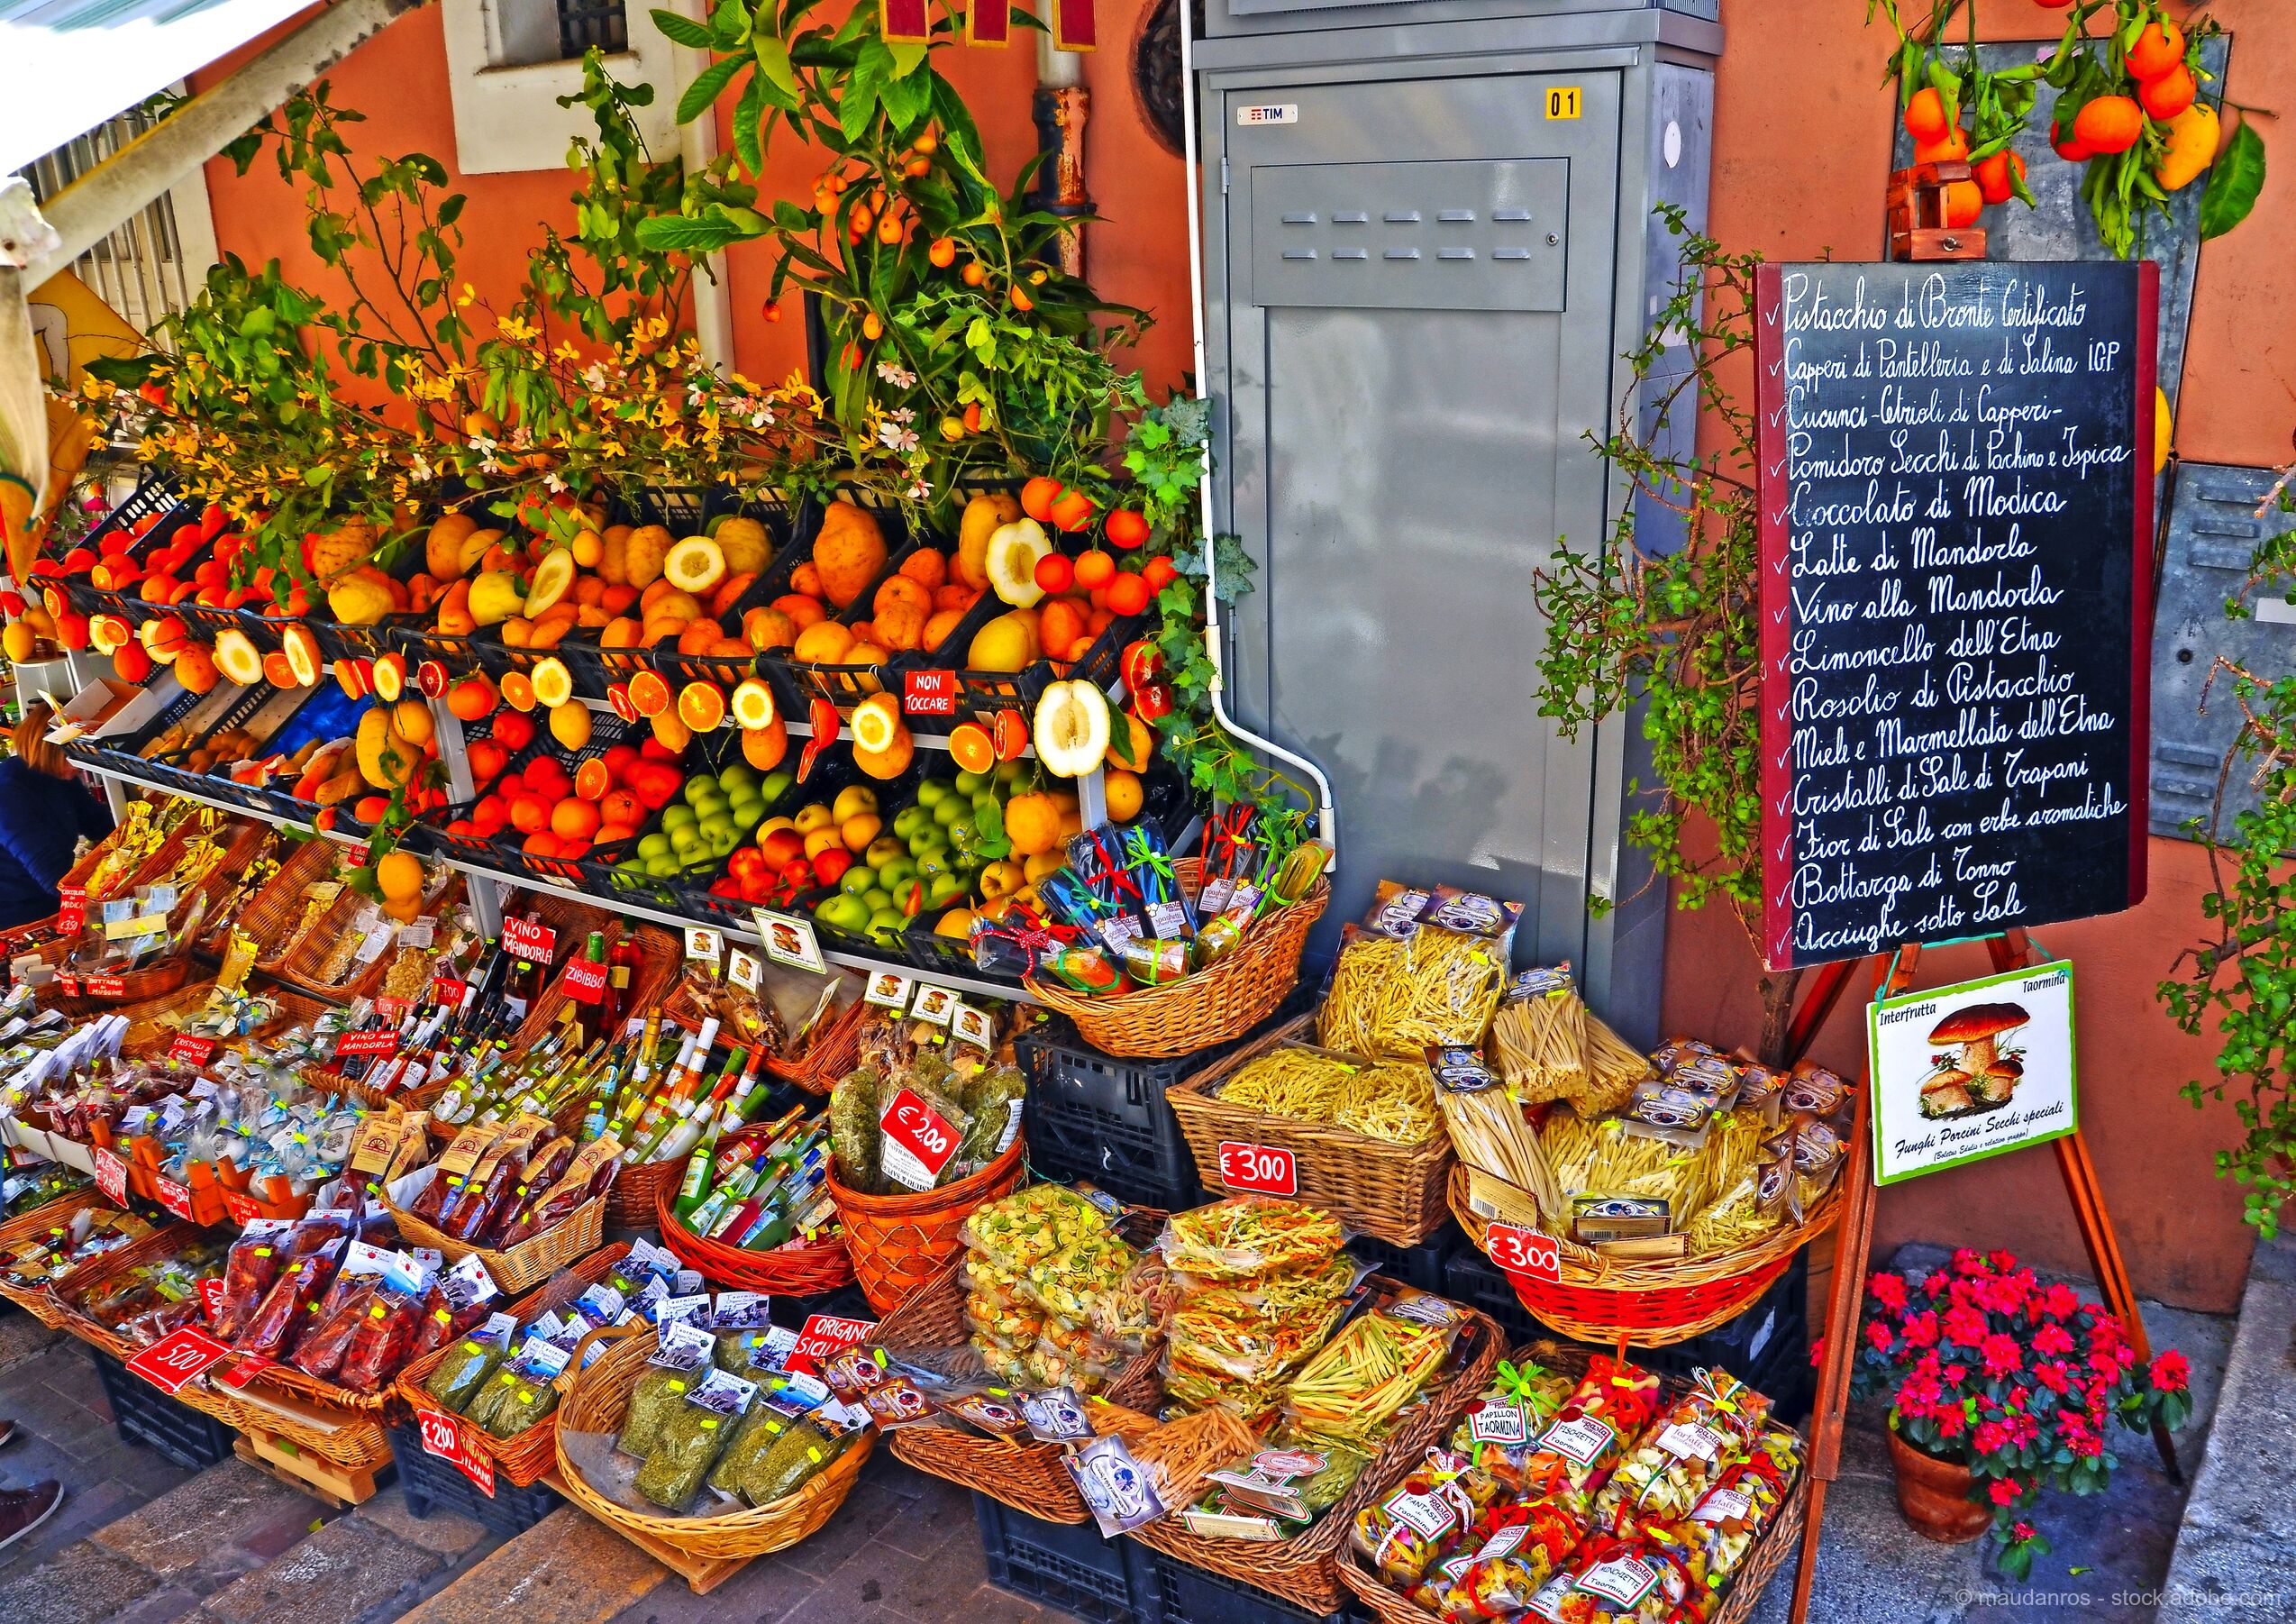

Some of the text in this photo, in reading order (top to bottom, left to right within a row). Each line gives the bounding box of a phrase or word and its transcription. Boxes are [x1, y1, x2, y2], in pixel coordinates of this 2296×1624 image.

[1263, 108, 1282, 119] TIM
[1783, 273, 2087, 338] Pistacchio di Bronte Certificato
[1785, 337, 1847, 388] Capperi
[1853, 341, 1872, 379] di
[1876, 337, 1973, 379] Pantelleria
[1980, 359, 1991, 377] e
[1996, 336, 2015, 375] di
[2019, 332, 2079, 375] Salina
[1786, 384, 1868, 431] Cucunci
[1947, 395, 1970, 423] di
[1786, 424, 2132, 481] Pomidoro Secchi di Pachino e Ispica
[1787, 476, 2068, 528] Cioccolato di Modica
[1790, 523, 2037, 579] Latte di Mandorla
[1790, 563, 2064, 625] Vino alla Mandorla
[1790, 616, 2063, 674] Limoncello dell'Etna
[916, 675, 941, 690] NON
[1792, 653, 2076, 722] Rosolio di Pistacchio
[906, 693, 948, 711] TOCCARE
[1791, 693, 2116, 771] Miele e Marmellata dell'Etna
[1791, 747, 2089, 818] Cristalli di Sale di Trapani
[1796, 780, 2128, 862] Fior di Sale con erbe aromatiche
[1790, 845, 2017, 914] Bottarga di Tonno
[61, 900, 84, 909] MODICA
[1793, 880, 2027, 953] Acciughe sotto Sale
[511, 919, 541, 939] VINO
[504, 936, 552, 965] MANDORLA
[88, 978, 123, 986] BOTTARGA
[2023, 973, 2065, 994] Taormina
[1879, 1002, 1936, 1026] Interfrutta
[174, 1038, 204, 1050] CRISTALLI
[342, 1041, 394, 1051] MANDORLA
[350, 1033, 377, 1041] VINO
[195, 1051, 210, 1059] SALE
[898, 1107, 919, 1126] €
[1894, 1100, 2064, 1159] Funghi Porcini Secchi speciali
[1934, 1148, 1957, 1163] (Boletus
[1960, 1143, 1978, 1154] Edulis
[1985, 1137, 2006, 1148] relativo
[1221, 1150, 1285, 1182] € 3.00
[1488, 1236, 1506, 1259] €
[1480, 1410, 1517, 1420] PAPILLON
[422, 1420, 432, 1443] €
[1478, 1422, 1521, 1436] TAORMINA
[1559, 1425, 1598, 1447] FISCHIETTI
[1583, 1420, 1608, 1437] pasta
[1695, 1427, 1722, 1444] pasta
[460, 1433, 489, 1469] RIGANO
[1550, 1436, 1585, 1456] Taormina
[1406, 1497, 1441, 1525] FANTASIA
[1429, 1499, 1452, 1520] pasta
[1708, 1499, 1737, 1511] arfalle
[1398, 1507, 1431, 1532] Taormina
[1599, 1565, 1641, 1590] MINCHIETTE
[1624, 1560, 1651, 1580] pasta
[1590, 1577, 1628, 1599] Taormina
